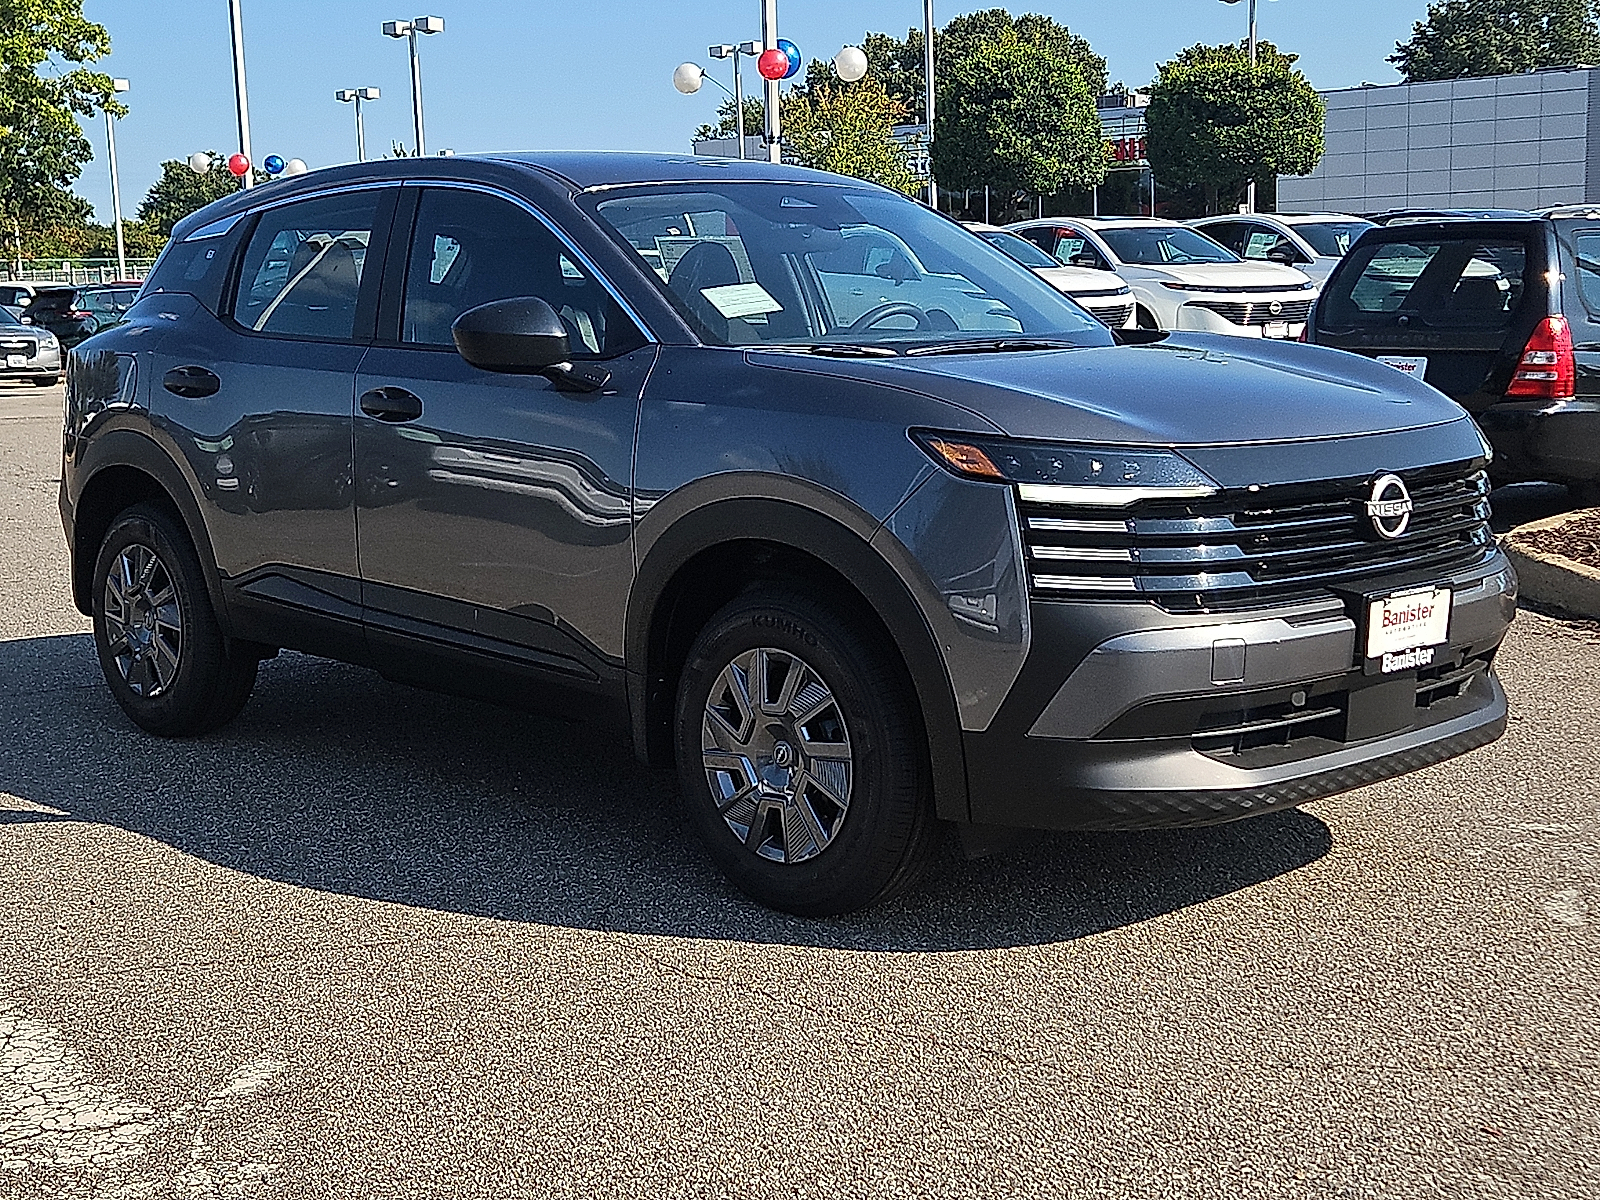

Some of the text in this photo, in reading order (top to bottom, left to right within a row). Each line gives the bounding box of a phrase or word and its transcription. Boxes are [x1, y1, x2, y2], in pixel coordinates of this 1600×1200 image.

[1382, 603, 1434, 628] Banister
[752, 614, 820, 646] KUMHO
[1382, 647, 1435, 673] Banister
